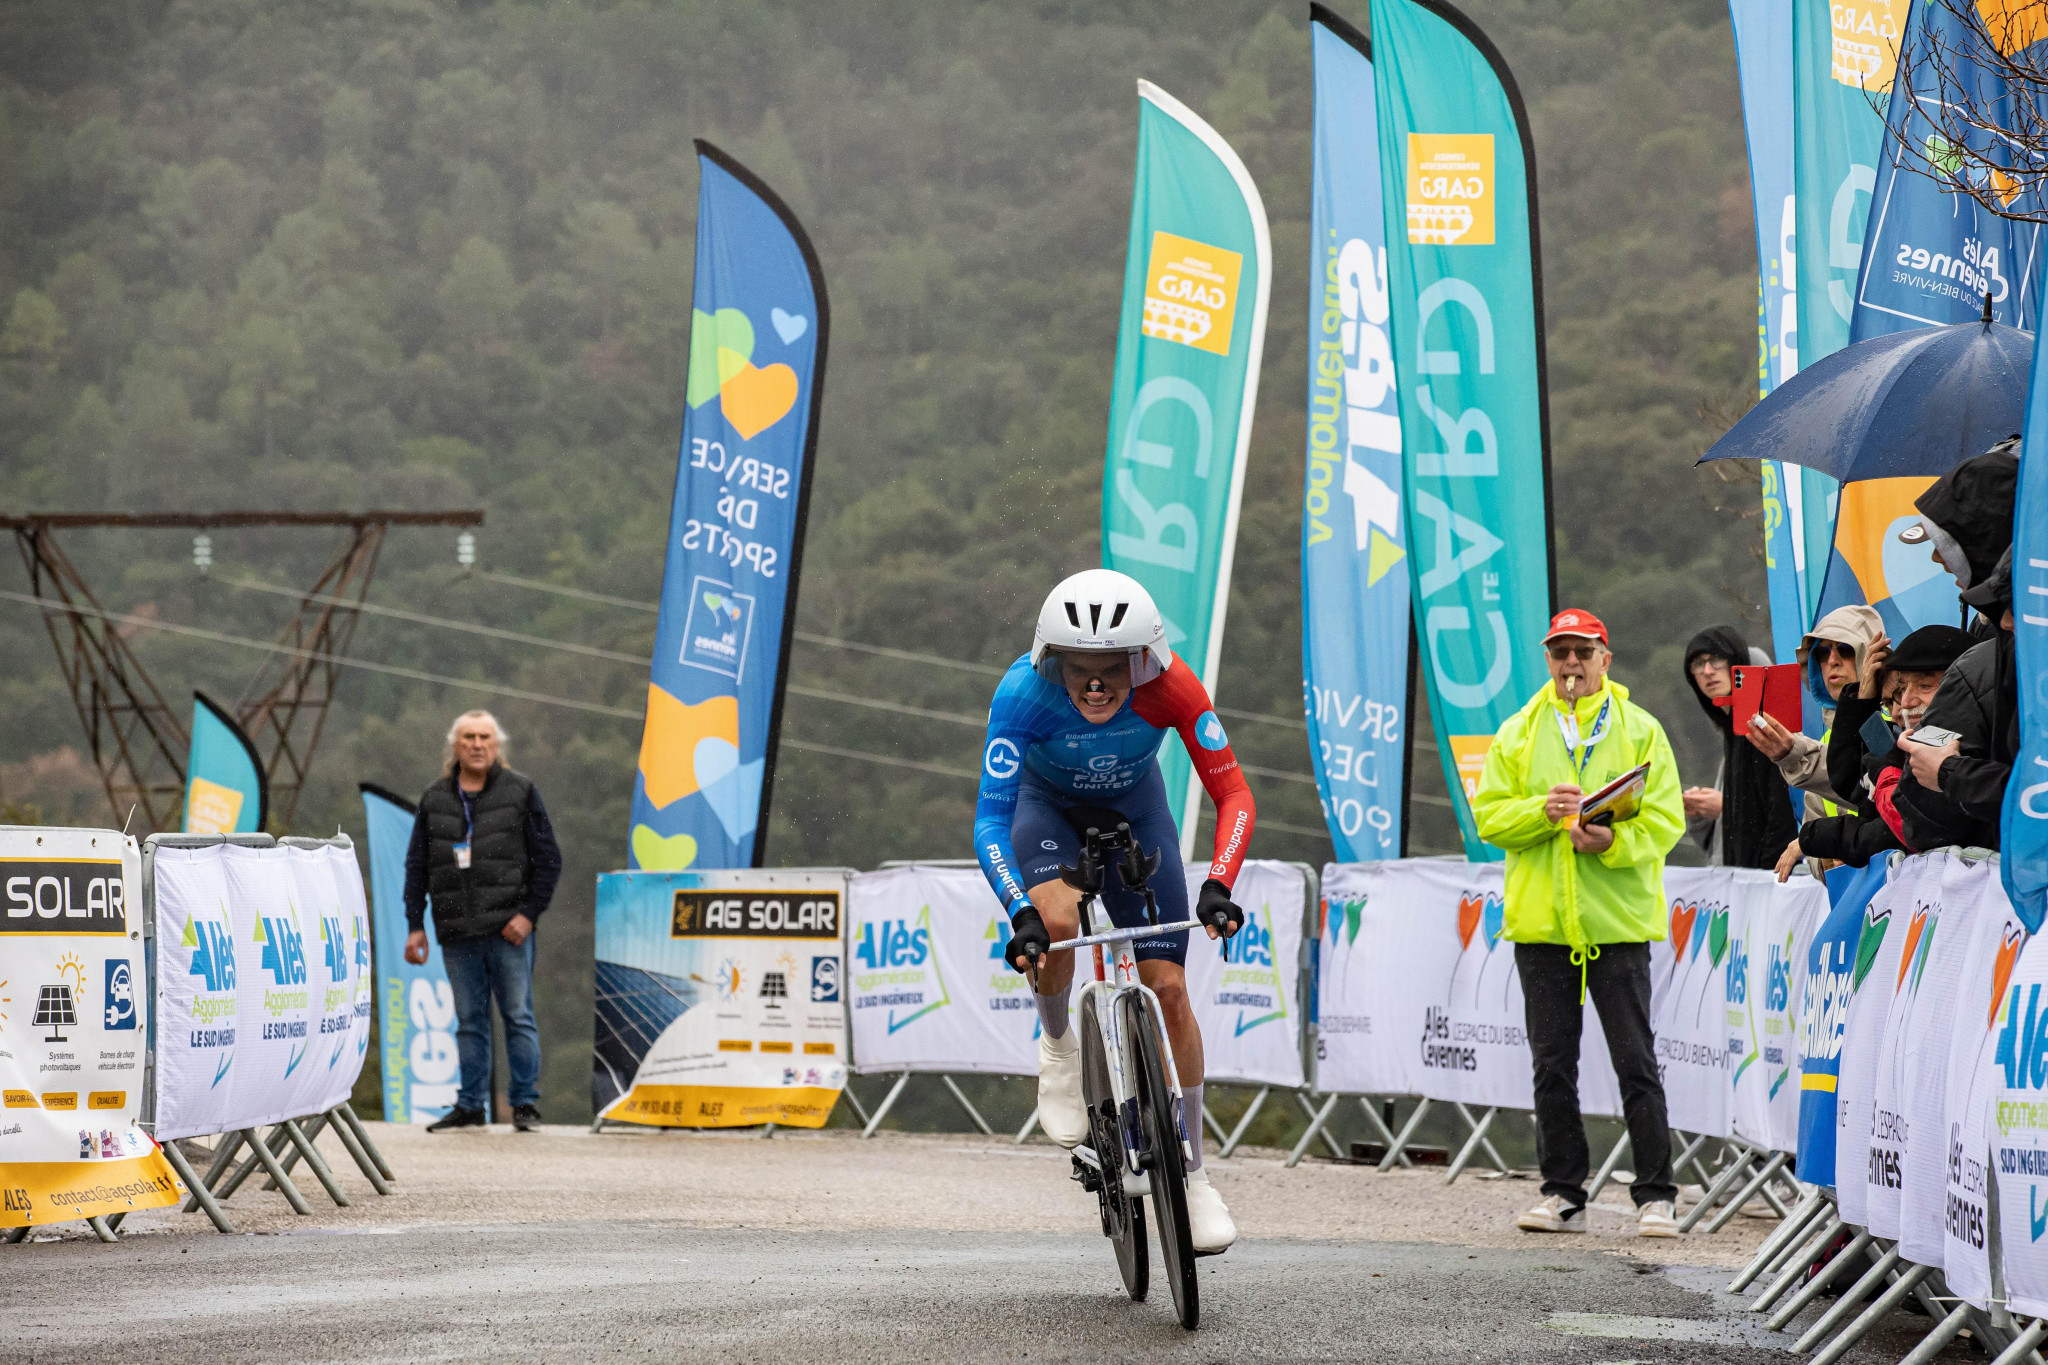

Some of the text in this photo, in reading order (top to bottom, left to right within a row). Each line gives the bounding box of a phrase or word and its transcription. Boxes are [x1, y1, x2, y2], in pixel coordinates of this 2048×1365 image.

[1219, 810, 1248, 863] Groupama
[986, 843, 1004, 868] FDJ
[996, 863, 1024, 900] UNITED
[6, 876, 125, 919] SOLAR
[705, 900, 836, 931] AG SOLAR
[261, 917, 307, 985] Alès
[856, 919, 929, 969] Alès
[190, 1030, 203, 1048] LE
[203, 1029, 217, 1048] SUD
[262, 1023, 273, 1040] LE
[273, 1023, 287, 1039] SUD
[2000, 1147, 2016, 1175] SUD
[4, 1188, 33, 1212] ALES
